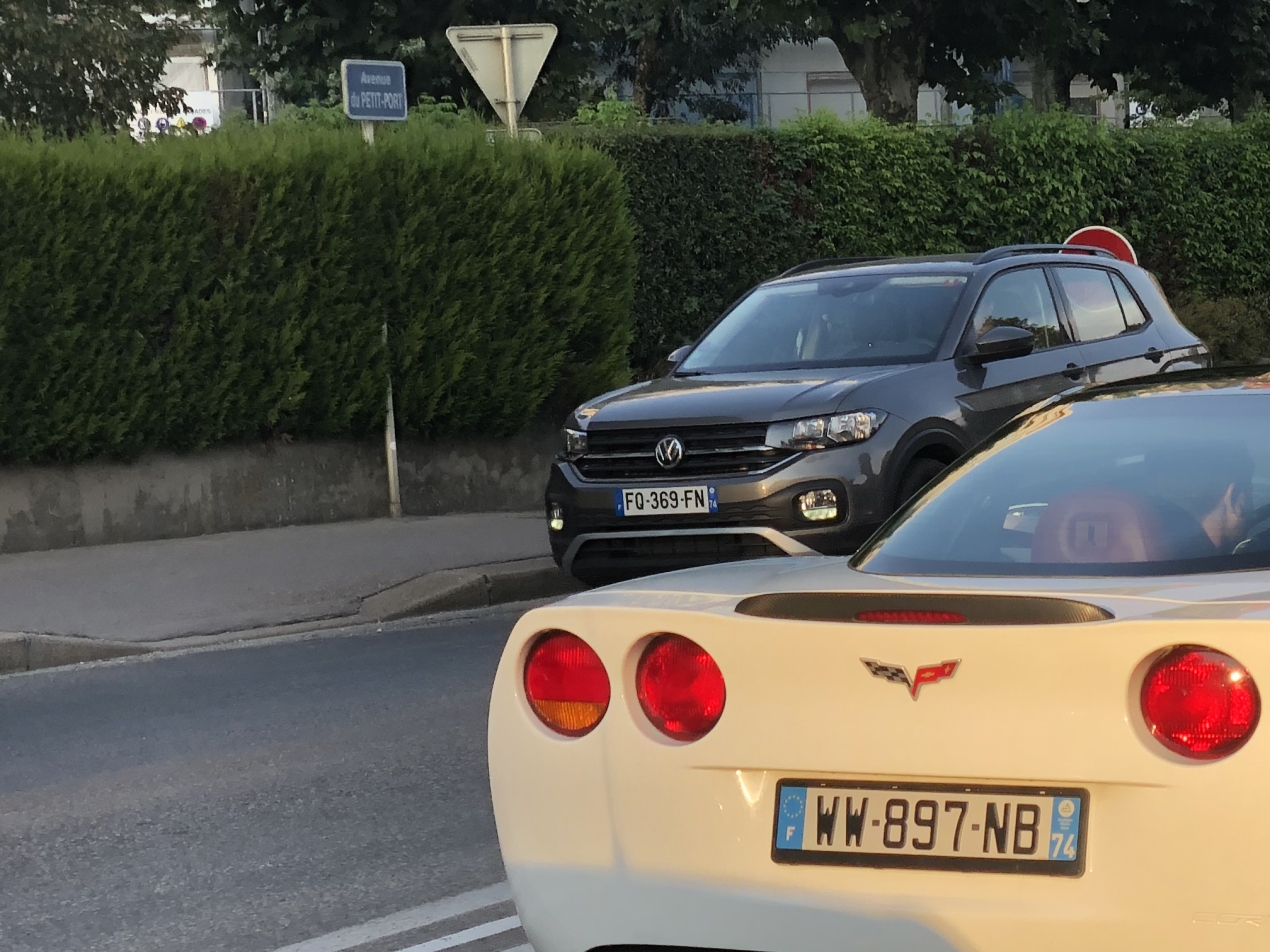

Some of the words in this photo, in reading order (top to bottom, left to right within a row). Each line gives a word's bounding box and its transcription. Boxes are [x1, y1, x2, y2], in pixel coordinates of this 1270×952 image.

[361, 71, 391, 85] Avenue
[351, 92, 360, 108] du
[361, 92, 403, 109] PETIT-PORT
[625, 489, 705, 511] FQ-369-FN
[709, 500, 718, 509] 74
[785, 826, 796, 841] F
[816, 796, 1041, 855] WW-897-NB
[1052, 834, 1075, 859] 74
